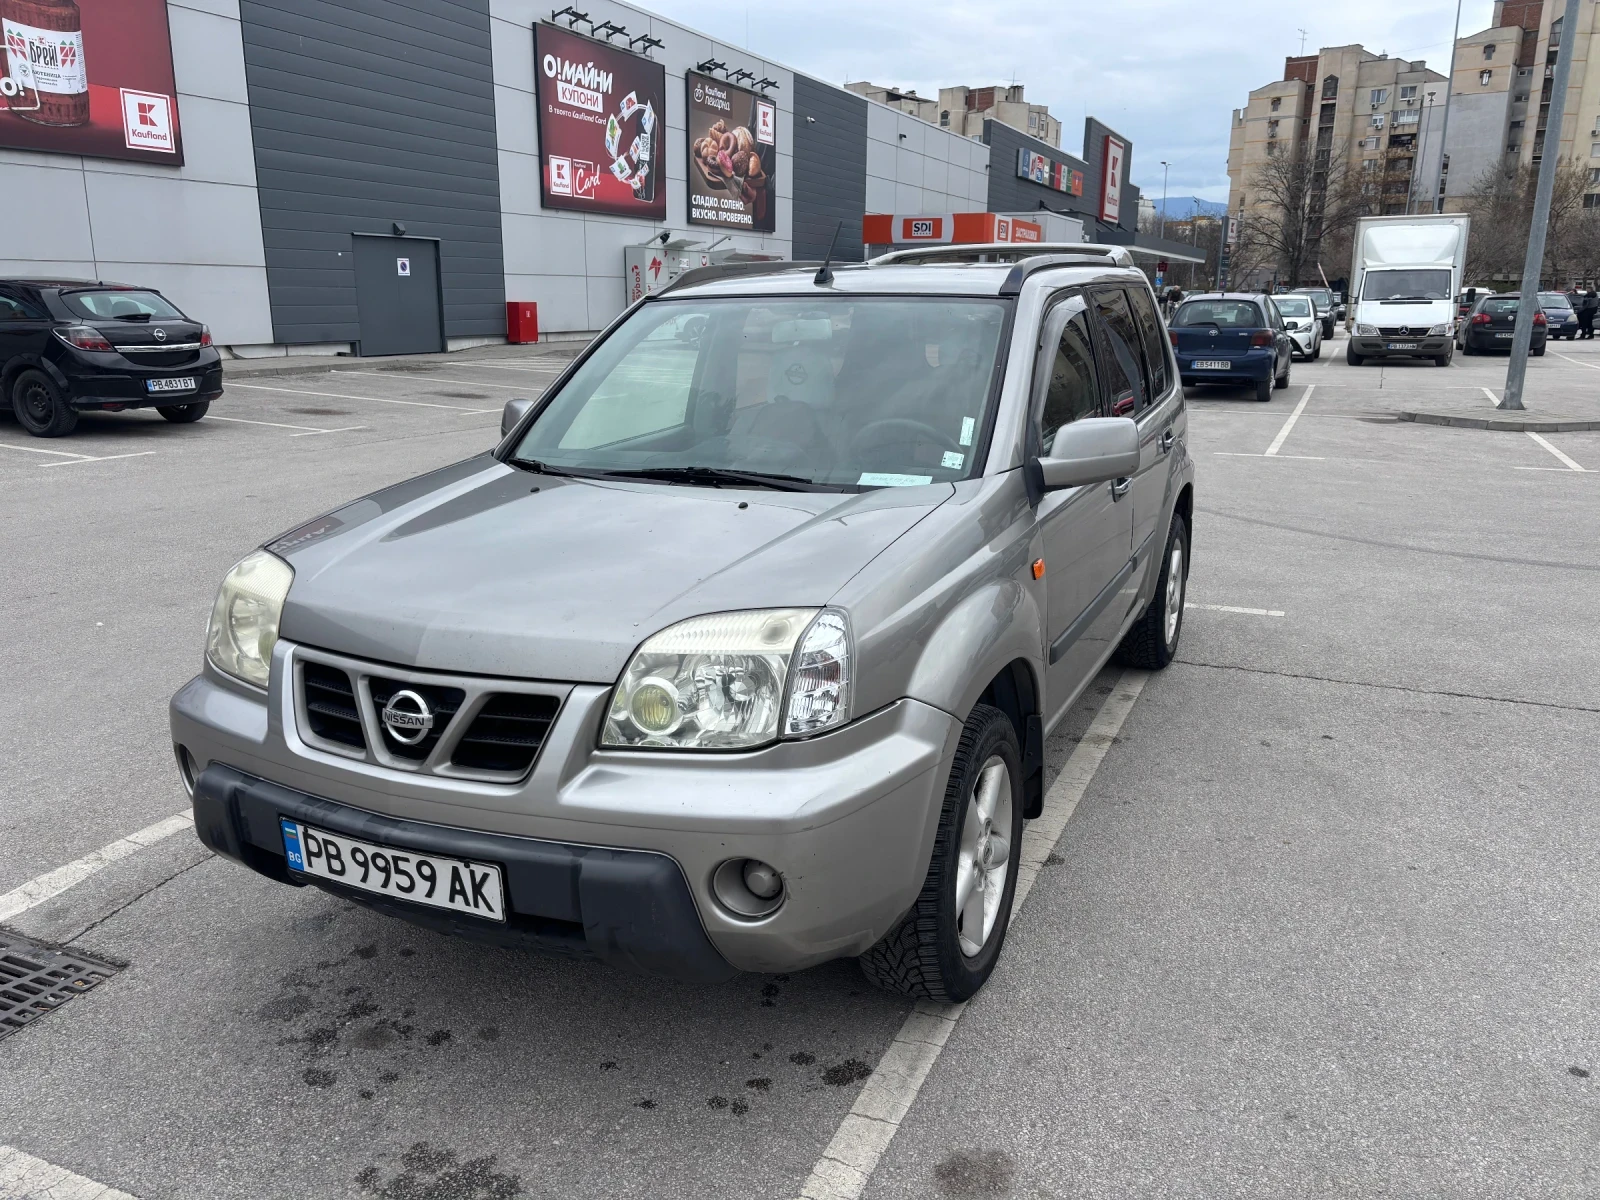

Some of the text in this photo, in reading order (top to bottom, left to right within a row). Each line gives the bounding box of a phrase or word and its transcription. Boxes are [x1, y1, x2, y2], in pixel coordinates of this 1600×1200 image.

[29, 41, 59, 67] Брей!
[561, 86, 599, 109] КУПОНИ
[704, 85, 727, 100] Kaufland
[548, 104, 607, 126] В твоята Kaufland Card
[131, 128, 168, 141] Kaufland
[575, 163, 601, 194] Card
[691, 194, 745, 211] СЛАДКО. СОЛЕНО.
[691, 207, 754, 225] ВКУСНО. ПРОВЕРЕНО.
[913, 222, 931, 233] SDI
[634, 271, 643, 301] sybox
[384, 711, 425, 726] NISSAN
[288, 850, 302, 864] BG
[302, 829, 496, 914] PB 9959 AK
